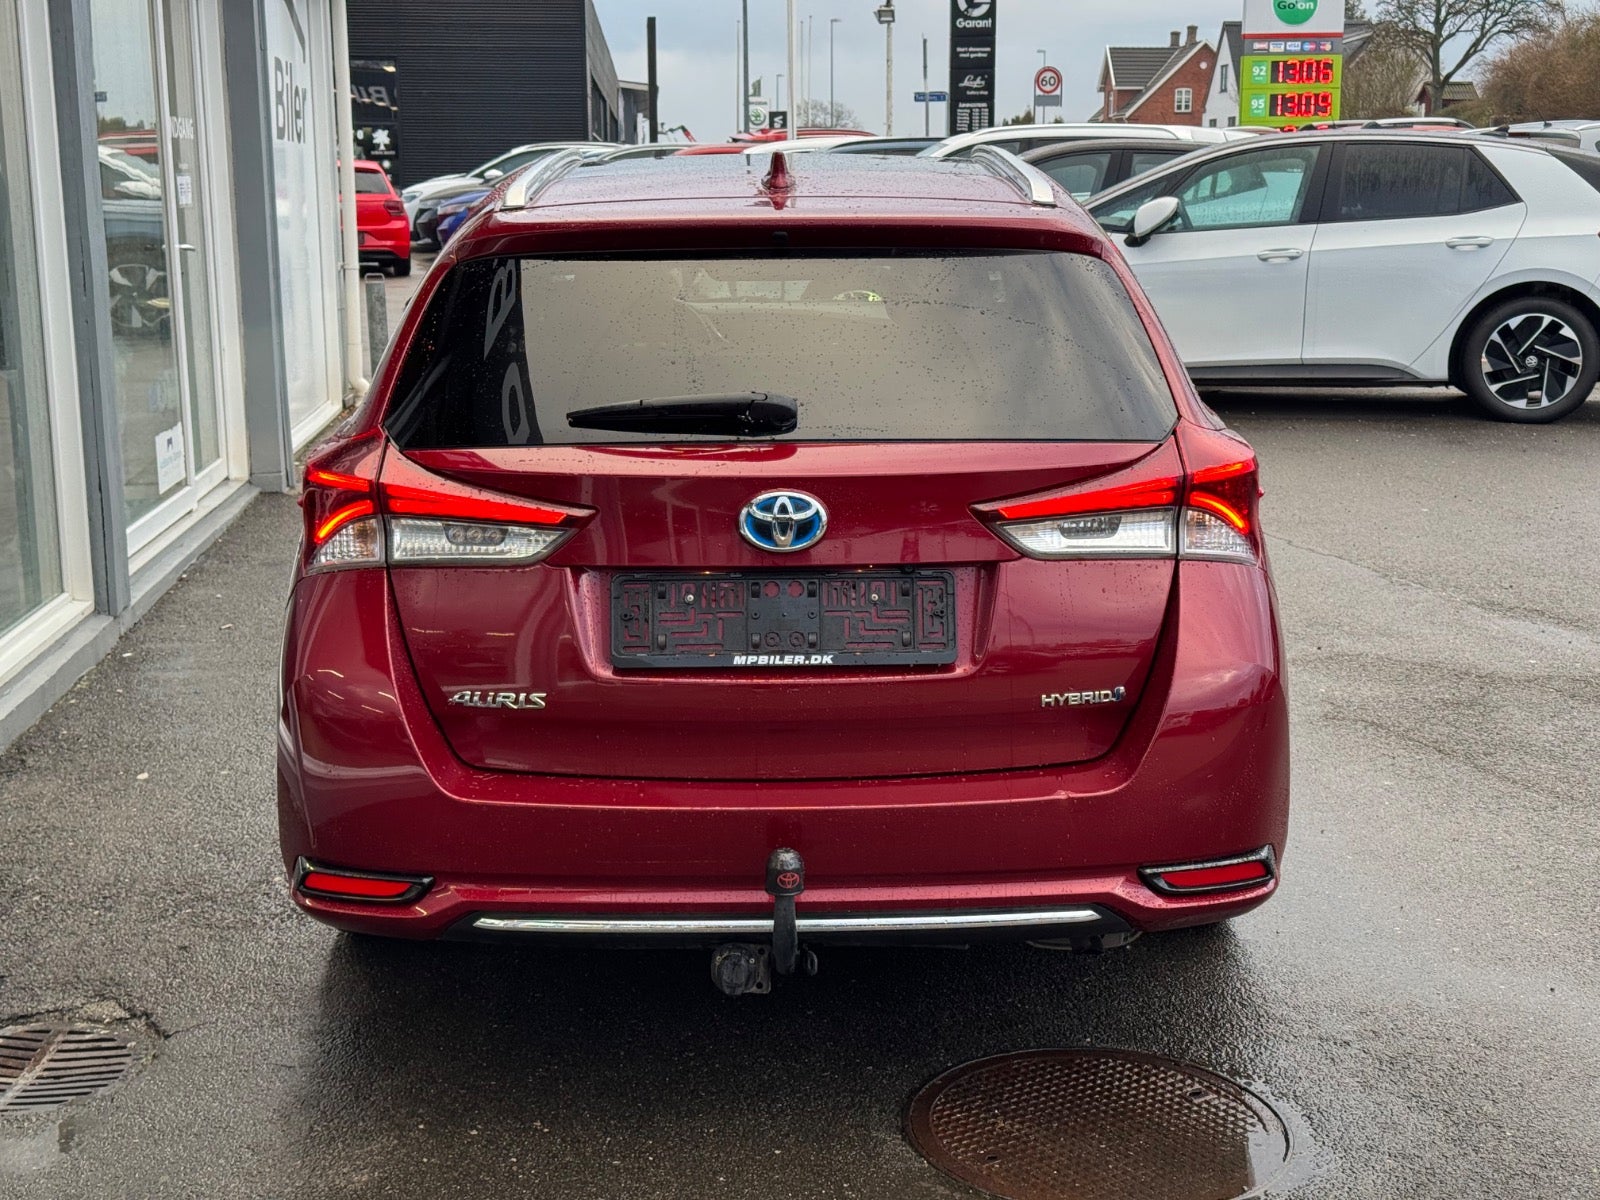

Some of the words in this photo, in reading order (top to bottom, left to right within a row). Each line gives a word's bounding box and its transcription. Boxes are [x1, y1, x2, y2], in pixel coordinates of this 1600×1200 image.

[956, 17, 992, 28] Garant
[1252, 66, 1266, 76] 92
[1041, 76, 1056, 87] 60
[274, 56, 306, 144] Biler
[1251, 98, 1264, 109] 95
[733, 655, 834, 665] MPBILER.DK
[448, 690, 547, 709] AURIS
[1041, 690, 1112, 707] HYBRID
